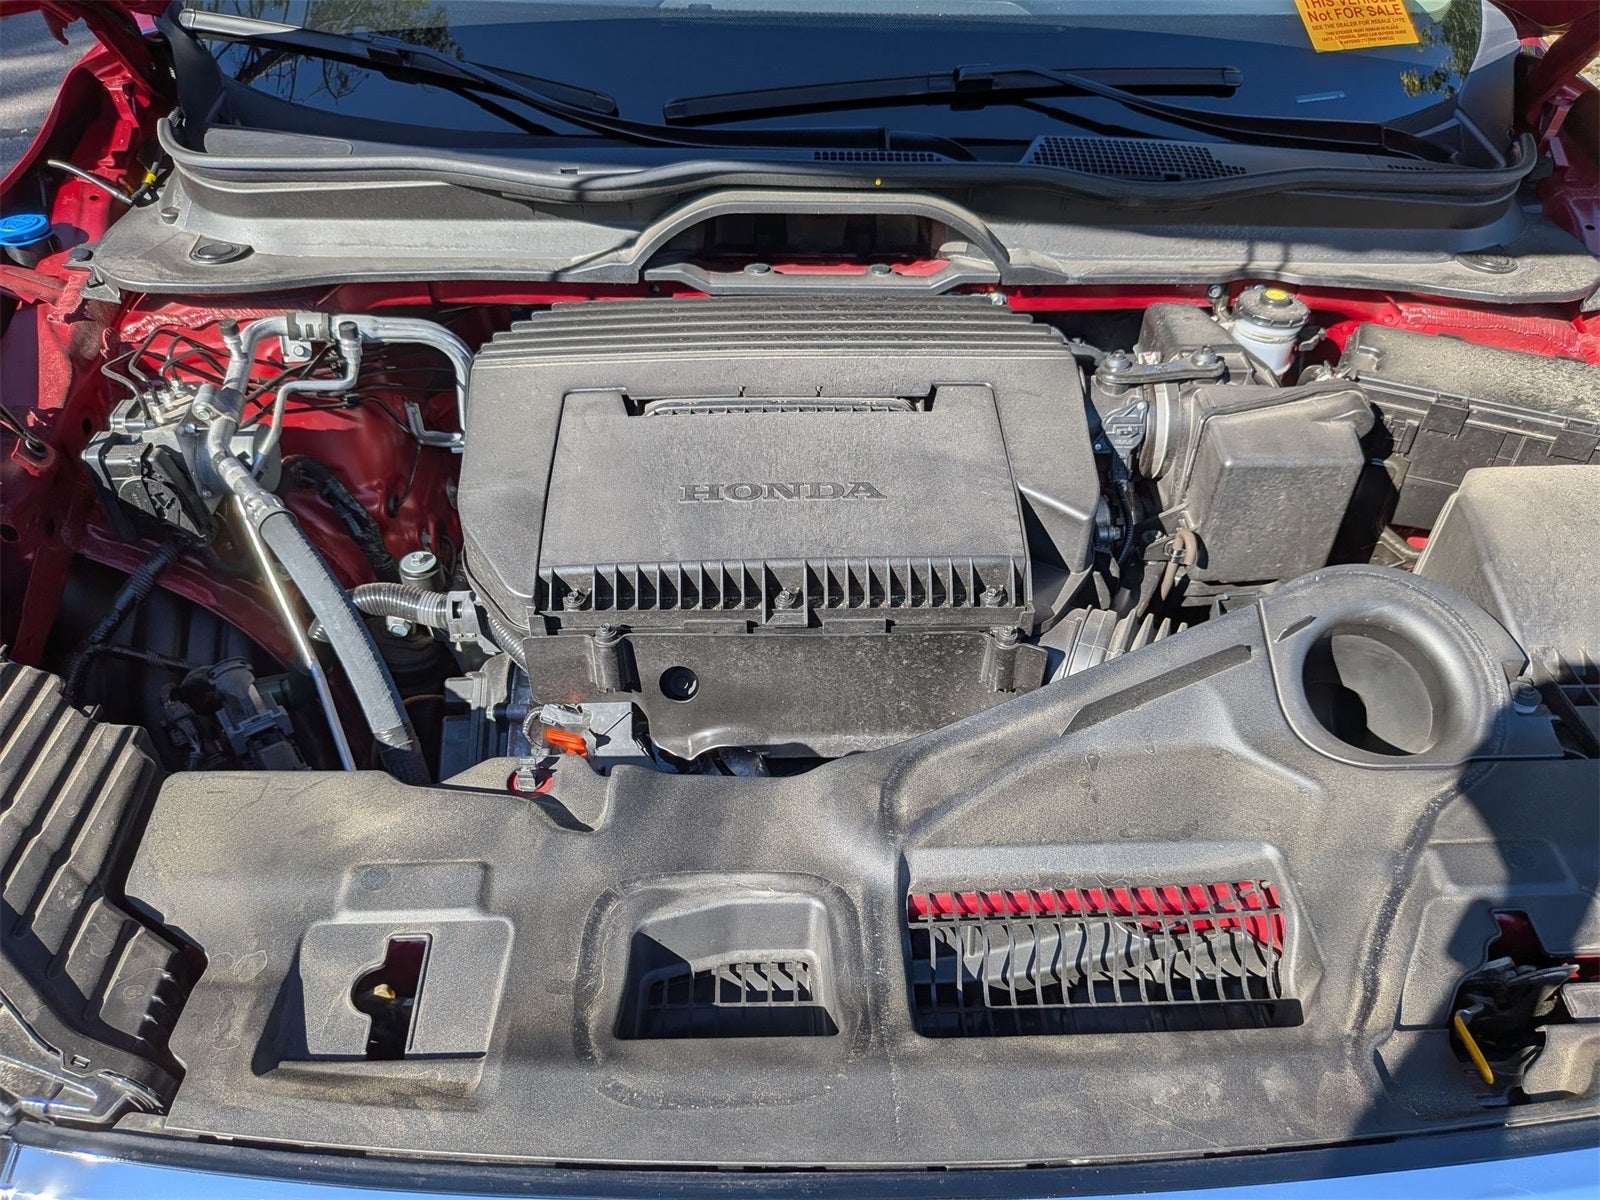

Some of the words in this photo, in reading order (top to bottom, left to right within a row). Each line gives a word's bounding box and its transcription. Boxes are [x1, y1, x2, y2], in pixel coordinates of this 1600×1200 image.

[1307, 10, 1332, 22] Not
[1334, 7, 1365, 19] FOR
[1367, 4, 1402, 17] SALE
[679, 481, 888, 503] HONDA
